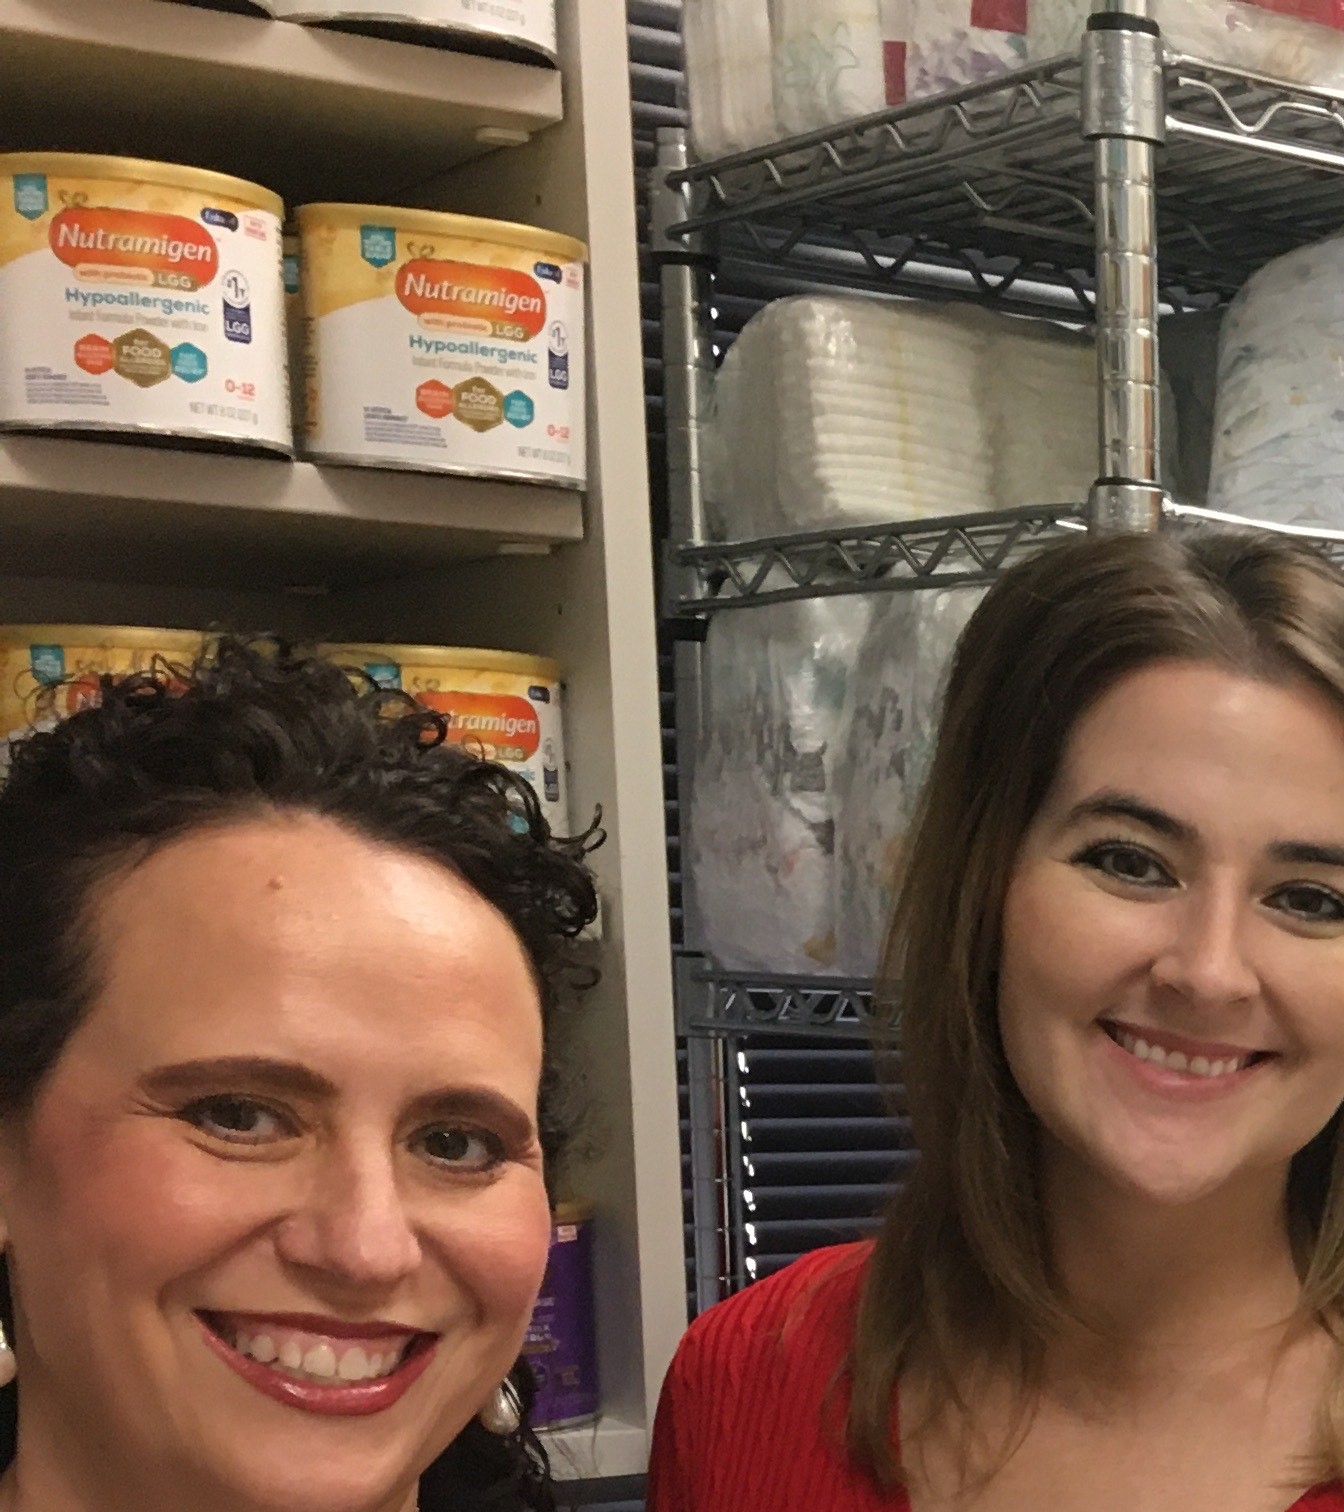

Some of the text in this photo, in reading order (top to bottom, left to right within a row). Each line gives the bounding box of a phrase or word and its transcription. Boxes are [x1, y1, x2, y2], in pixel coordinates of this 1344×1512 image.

[57, 223, 212, 264] Nutramigen
[158, 273, 193, 289] LGG
[65, 287, 211, 316] Hypoallergenic
[404, 272, 542, 315] Nutramigen
[225, 321, 250, 335] LGG
[495, 325, 525, 339] LGG
[122, 346, 162, 360] FOOD
[409, 334, 538, 364] Hypoallergenic
[461, 392, 497, 405] FOOD
[447, 709, 536, 738] tramigen
